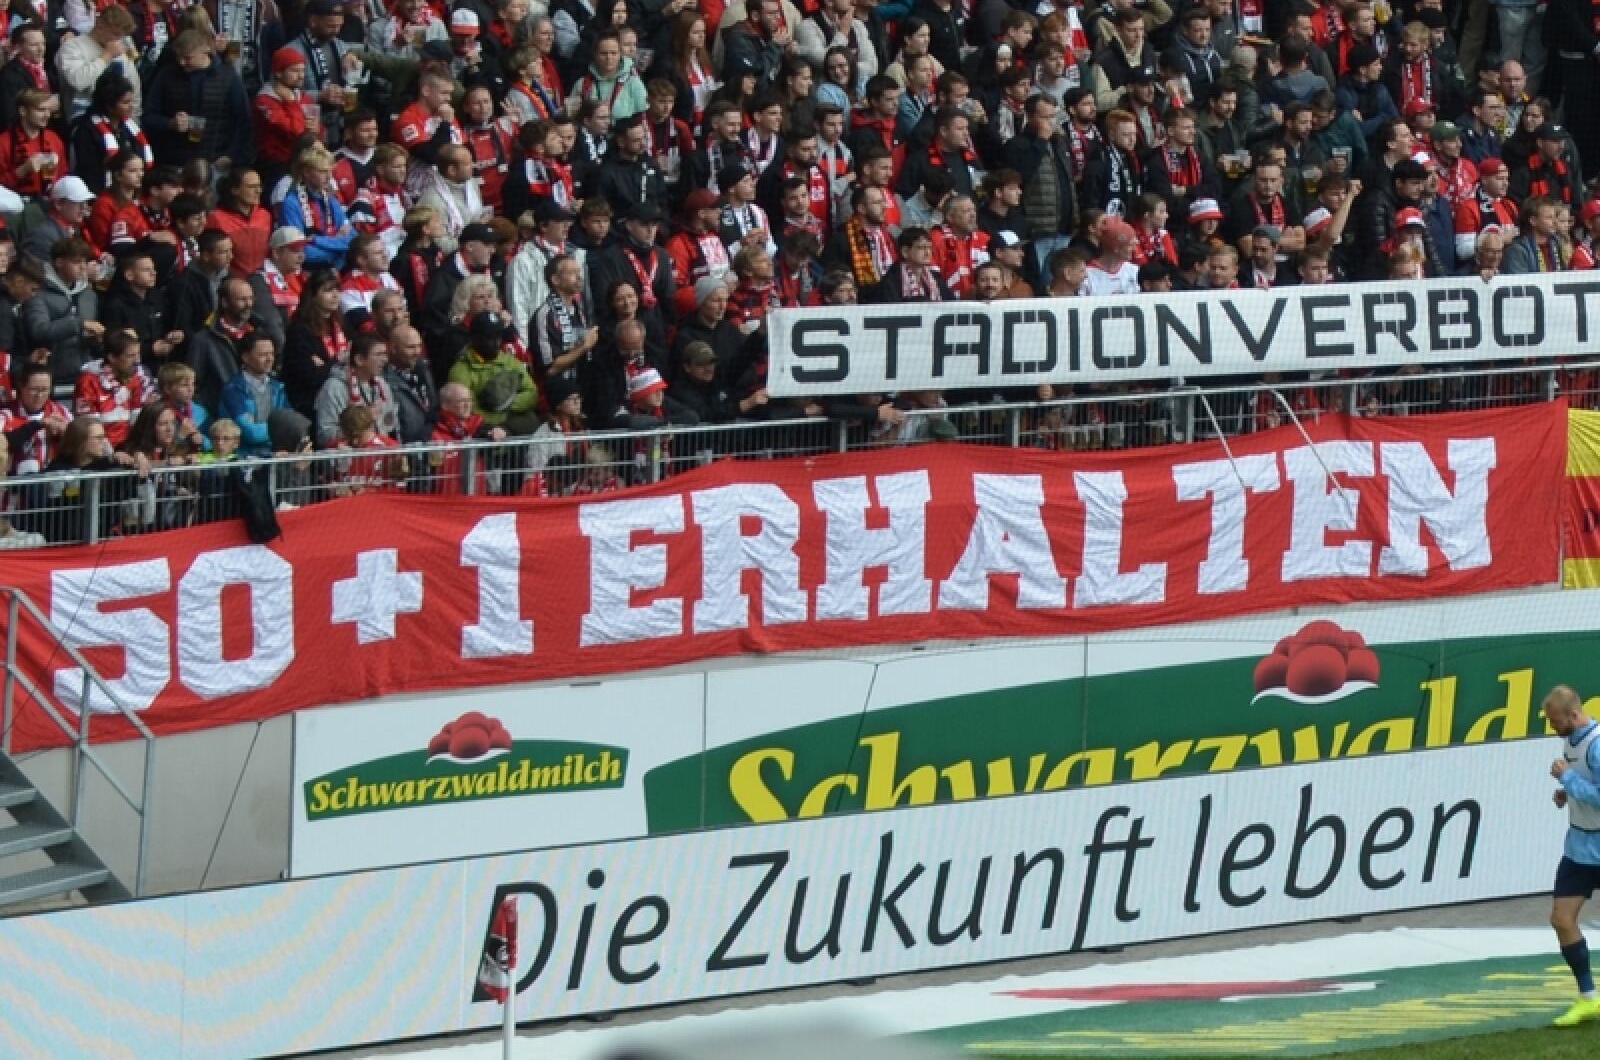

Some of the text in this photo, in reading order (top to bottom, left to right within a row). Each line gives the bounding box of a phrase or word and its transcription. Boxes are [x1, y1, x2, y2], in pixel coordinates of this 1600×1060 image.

[576, 437, 1497, 647] ERHALTEN
[308, 749, 623, 813] Schwarzwaldmilch
[471, 782, 1482, 1004] Die Zukunft leben
